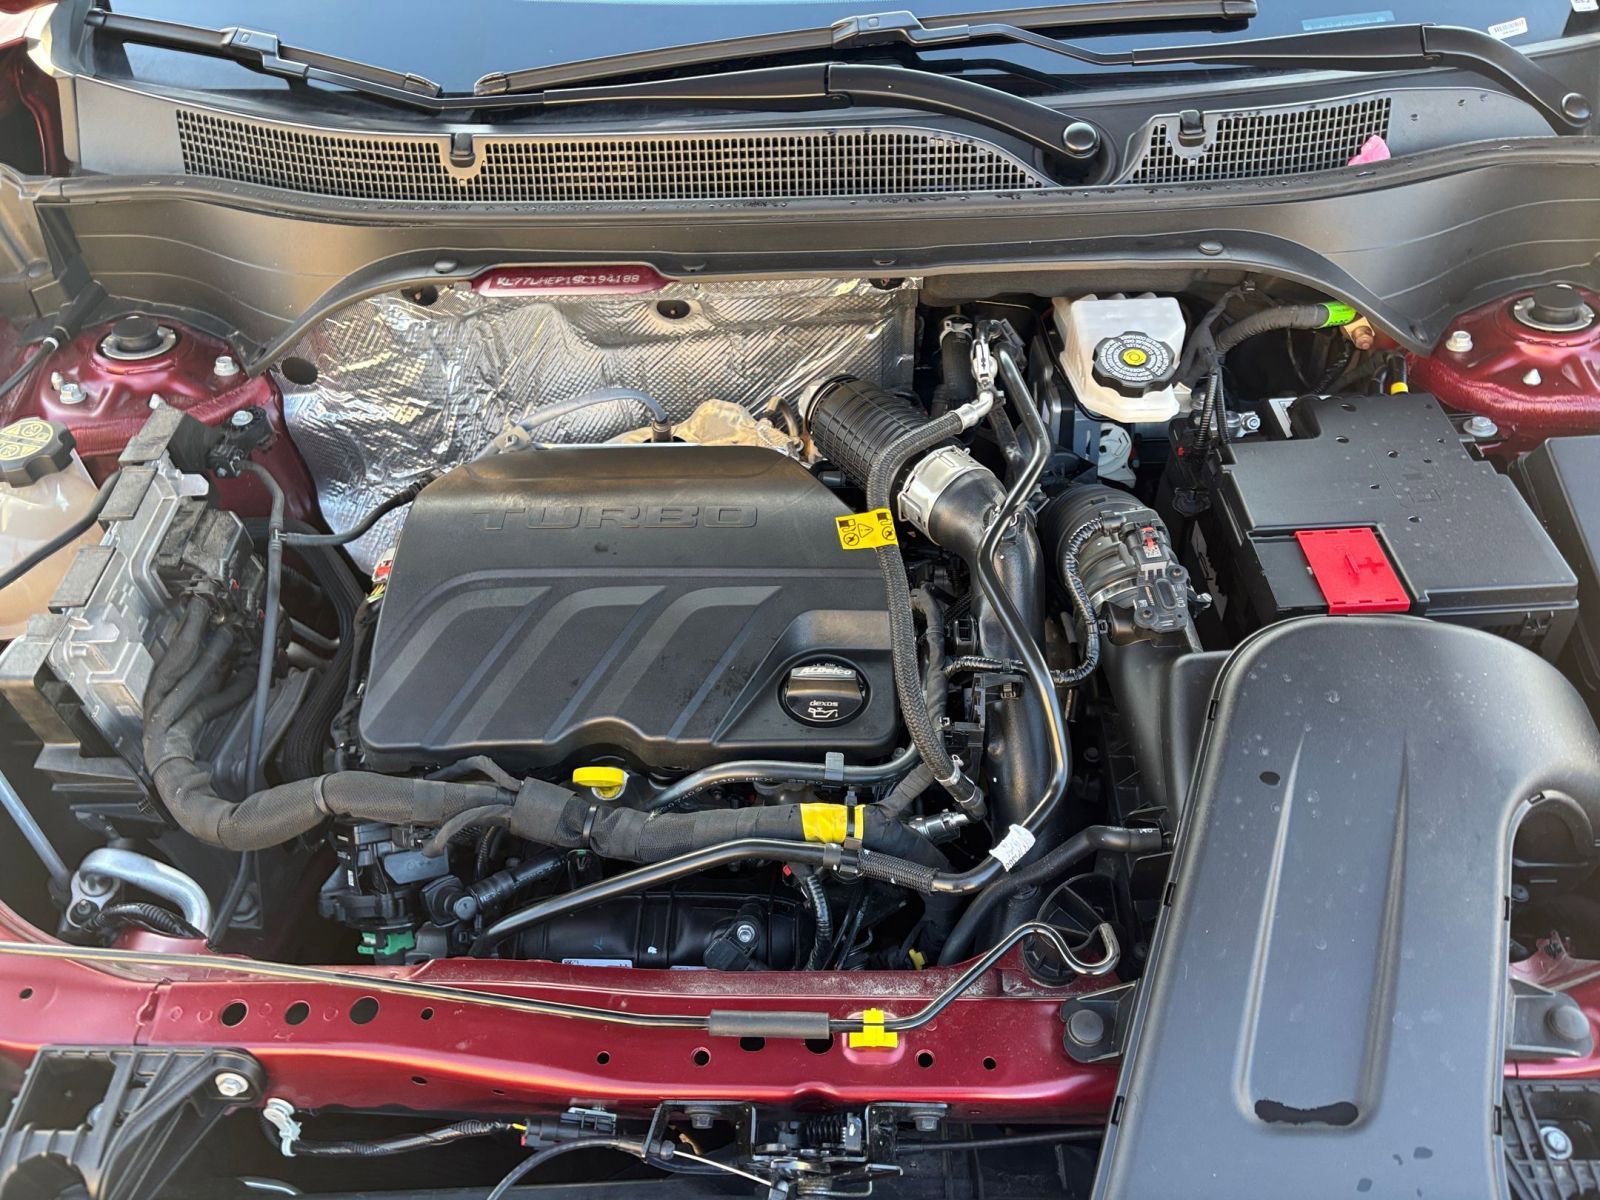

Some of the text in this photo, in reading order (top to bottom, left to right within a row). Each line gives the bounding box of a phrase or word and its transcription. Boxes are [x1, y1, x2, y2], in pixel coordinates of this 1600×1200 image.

[472, 505, 758, 530] TURBO
[800, 666, 852, 675] ACDelco
[809, 699, 839, 707] dexos
